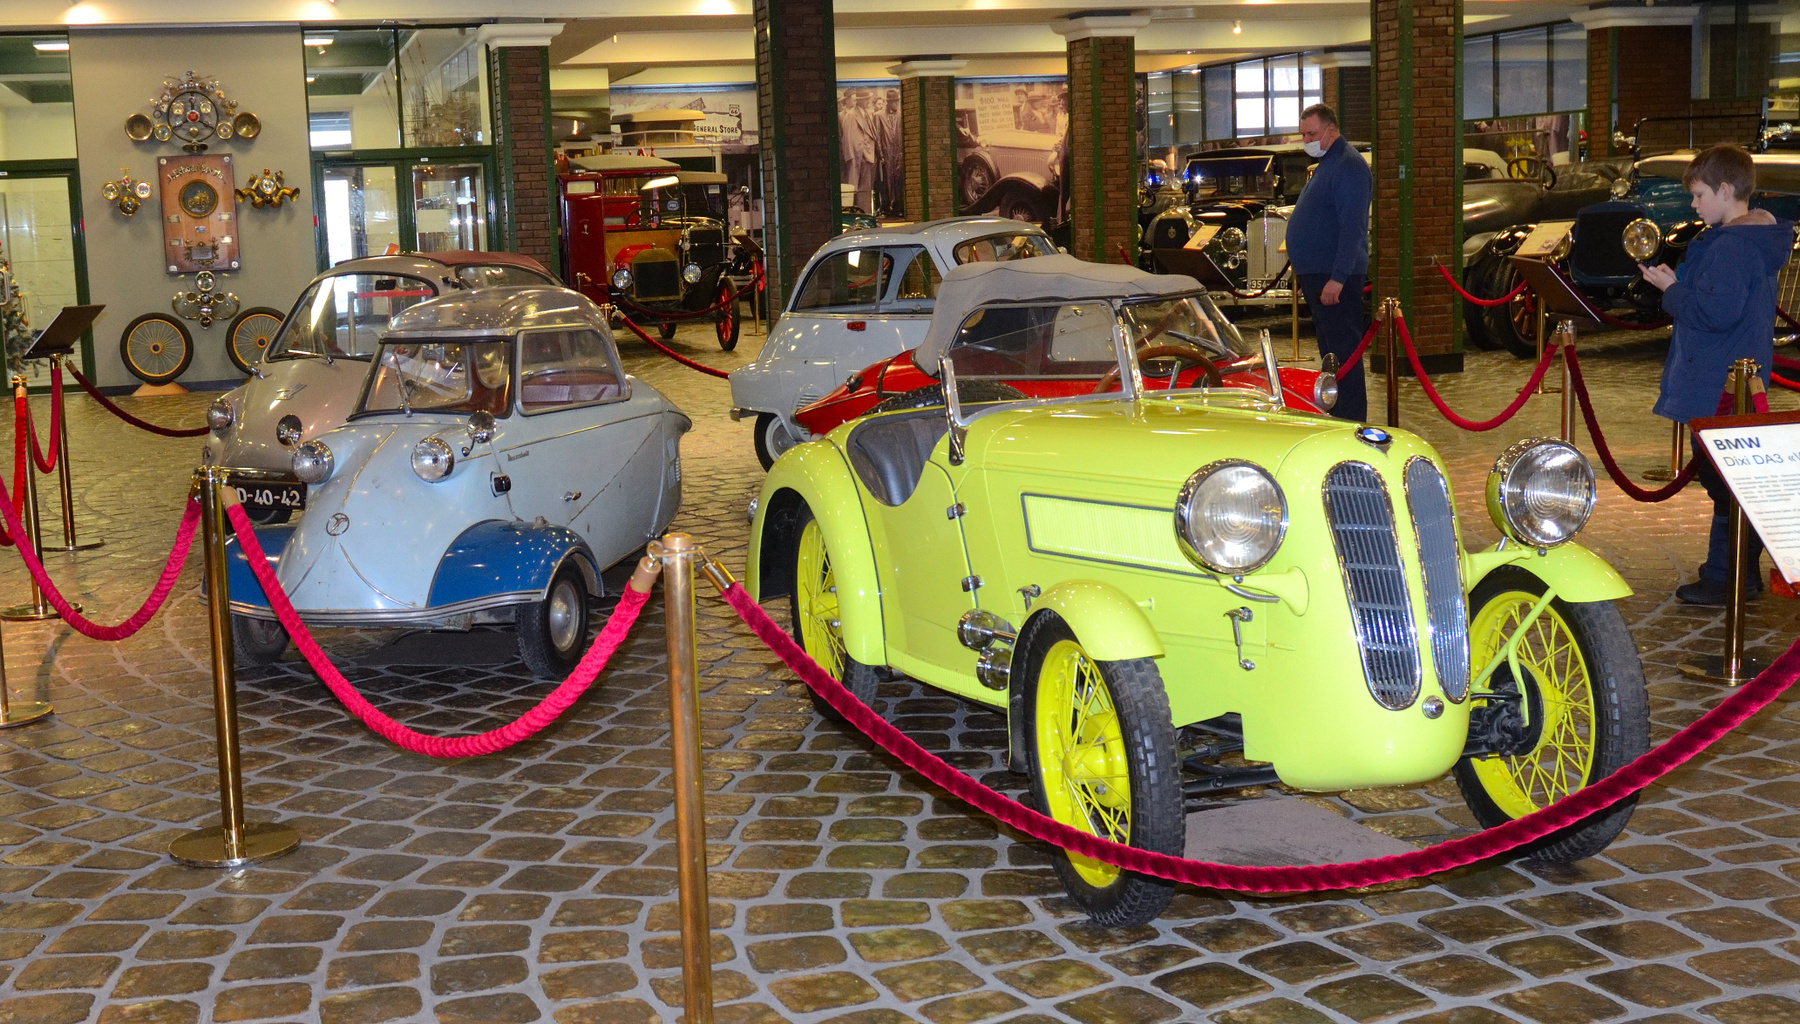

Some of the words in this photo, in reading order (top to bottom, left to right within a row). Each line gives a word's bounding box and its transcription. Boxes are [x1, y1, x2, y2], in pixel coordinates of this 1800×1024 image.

[720, 125, 738, 133] STORE
[1713, 437, 1761, 450] BMW
[1724, 456, 1750, 467] Dixi
[1752, 454, 1784, 465] DA3
[234, 487, 300, 506] D-40-42
